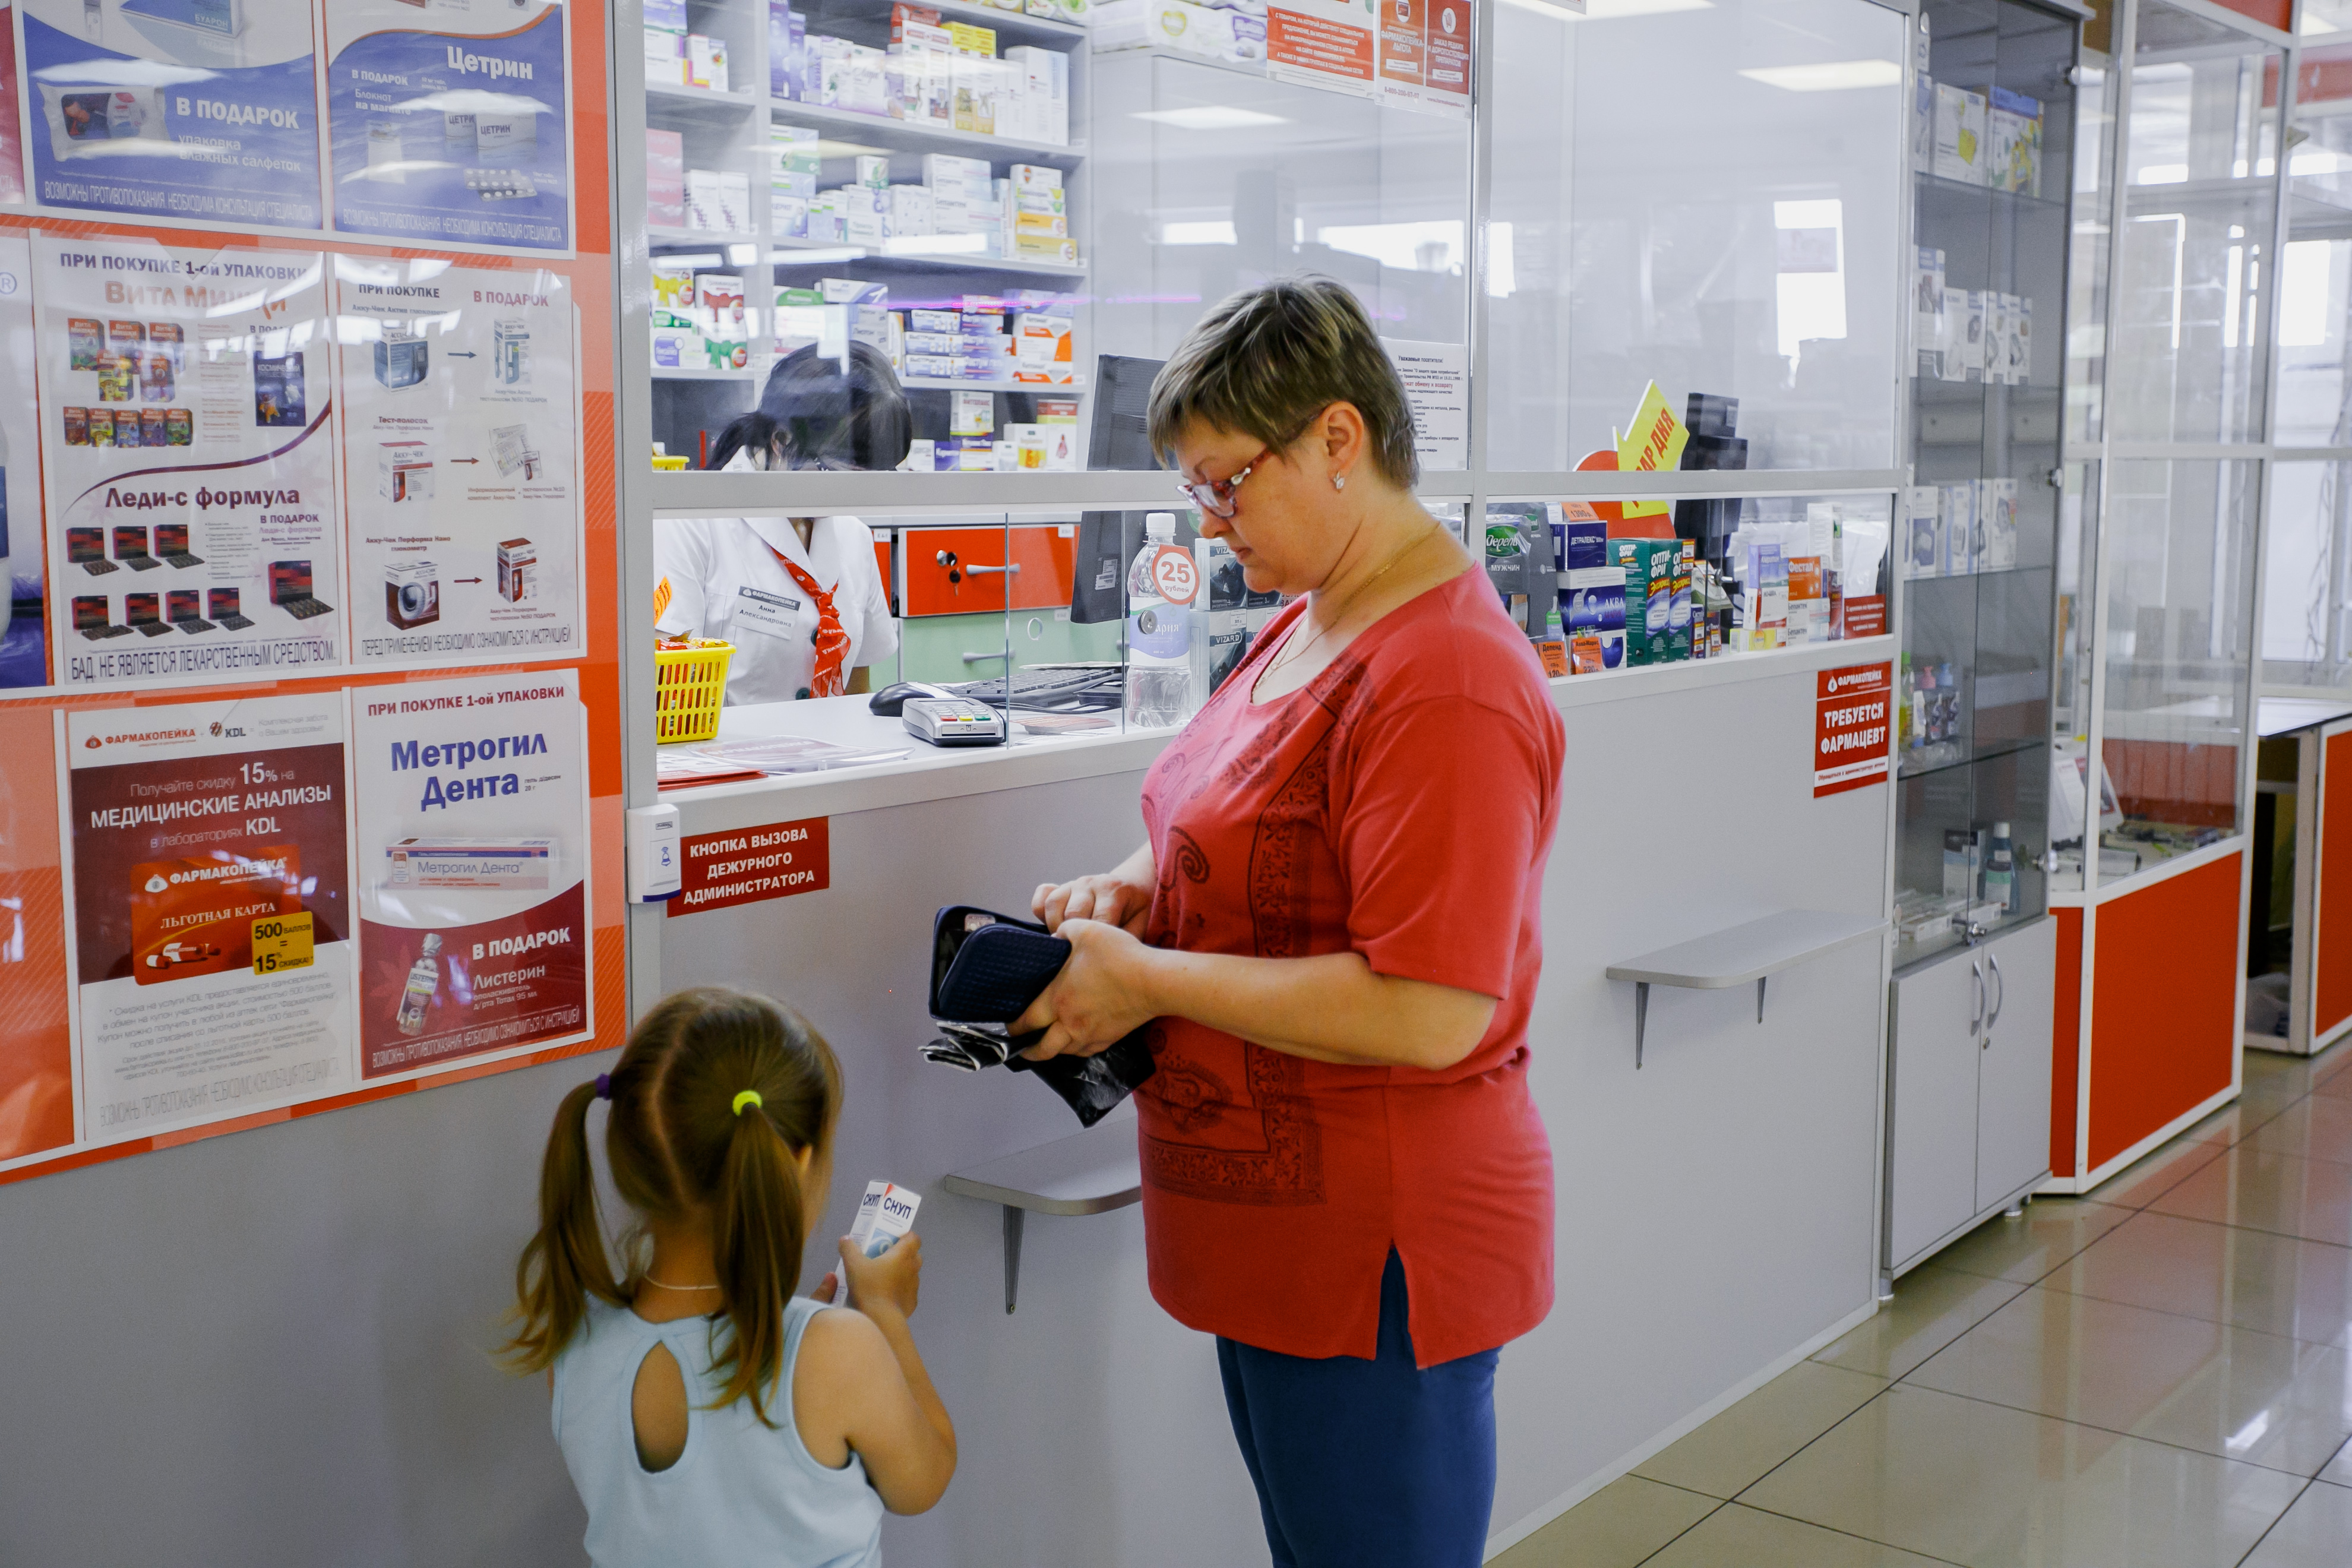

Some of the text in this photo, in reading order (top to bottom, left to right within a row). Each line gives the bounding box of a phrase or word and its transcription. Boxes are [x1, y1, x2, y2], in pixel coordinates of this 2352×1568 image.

[195, 14, 228, 27] БУАРОН
[447, 46, 533, 80] Цетрин
[352, 69, 408, 86] В ПОДАРОК
[355, 88, 391, 102] Блокнот
[176, 97, 299, 129] В ПОДАРОК
[356, 102, 368, 110] на
[481, 125, 510, 135] ЦЕТРИН
[178, 134, 241, 151] упаковка
[242, 156, 301, 172] салфеток
[45, 181, 88, 201] ВОЗМОЖНЫ
[60, 253, 307, 280] ПРИ ПОКУПКЕ 1-ой УПАКОВКИ
[359, 284, 440, 298] ПРИ ПОКУПКЕ
[473, 290, 549, 307] В ПОДАРОК
[1651, 407, 1674, 459] ДНЯ
[105, 486, 300, 510] Леди-с формула
[260, 514, 320, 524] В ПОДАРОК
[1651, 550, 1671, 566] ОПТИ-
[1789, 561, 1813, 573] Фестал
[1161, 561, 1190, 584] 25
[1651, 564, 1667, 578] ФРИ
[752, 590, 796, 607] ФАРМАКОПЕЙКА
[1165, 585, 1190, 593] рублей
[758, 605, 775, 614] Анна
[1605, 598, 1624, 608] АКВА
[739, 609, 791, 627] Александровна
[362, 638, 383, 656] ПЕРЕД
[477, 630, 523, 648] ОЗНАКОМИТЬСЯ
[1216, 634, 1240, 644] VIZARD
[1542, 644, 1562, 653] Депенд
[72, 640, 336, 683] БАД. НЕ ЯВЛЯЕТСЯ ЛЕКАРСТВЕННЫМ СРЕДСТВОМ.
[1838, 670, 1882, 687] ФАРМАКОПЕЙКА
[368, 686, 565, 716] ПРИ ПОКУПКЕ 1-ой УПАКОВКИ
[1825, 701, 1884, 729] ТРЕБУЕТСЯ
[105, 728, 197, 745] ФАРМАКОПЕЙКА
[225, 728, 246, 738] KDL
[1821, 726, 1886, 754] ФАРМАЦЕВТ
[390, 733, 548, 772] Метрогил
[240, 762, 295, 785] 15% на
[131, 775, 236, 797] Получайте скидку
[420, 773, 519, 812] Дента
[91, 785, 331, 829] МЕДИЦИНСКИЕ АНАЛИЗЫ
[151, 816, 281, 848] в лабораториях KDL
[690, 828, 808, 858] КНОПКА ВЫЗОВА
[169, 858, 286, 884] ФАРМАКОПЕЙКА
[418, 861, 520, 875] Метрогил Дента
[707, 852, 792, 880] ДЕЖУРНОГО
[684, 870, 814, 905] АДМИНИСТРАТОРА
[160, 902, 276, 930] ЛЬГОТНАЯ КАРТА
[255, 922, 282, 940] 500
[472, 927, 571, 960] В ПОДАРОК
[473, 965, 545, 991] Листерин
[473, 985, 530, 1000] ополаскиватель
[863, 1193, 881, 1207] СНУП
[884, 1197, 912, 1219] СНУП
